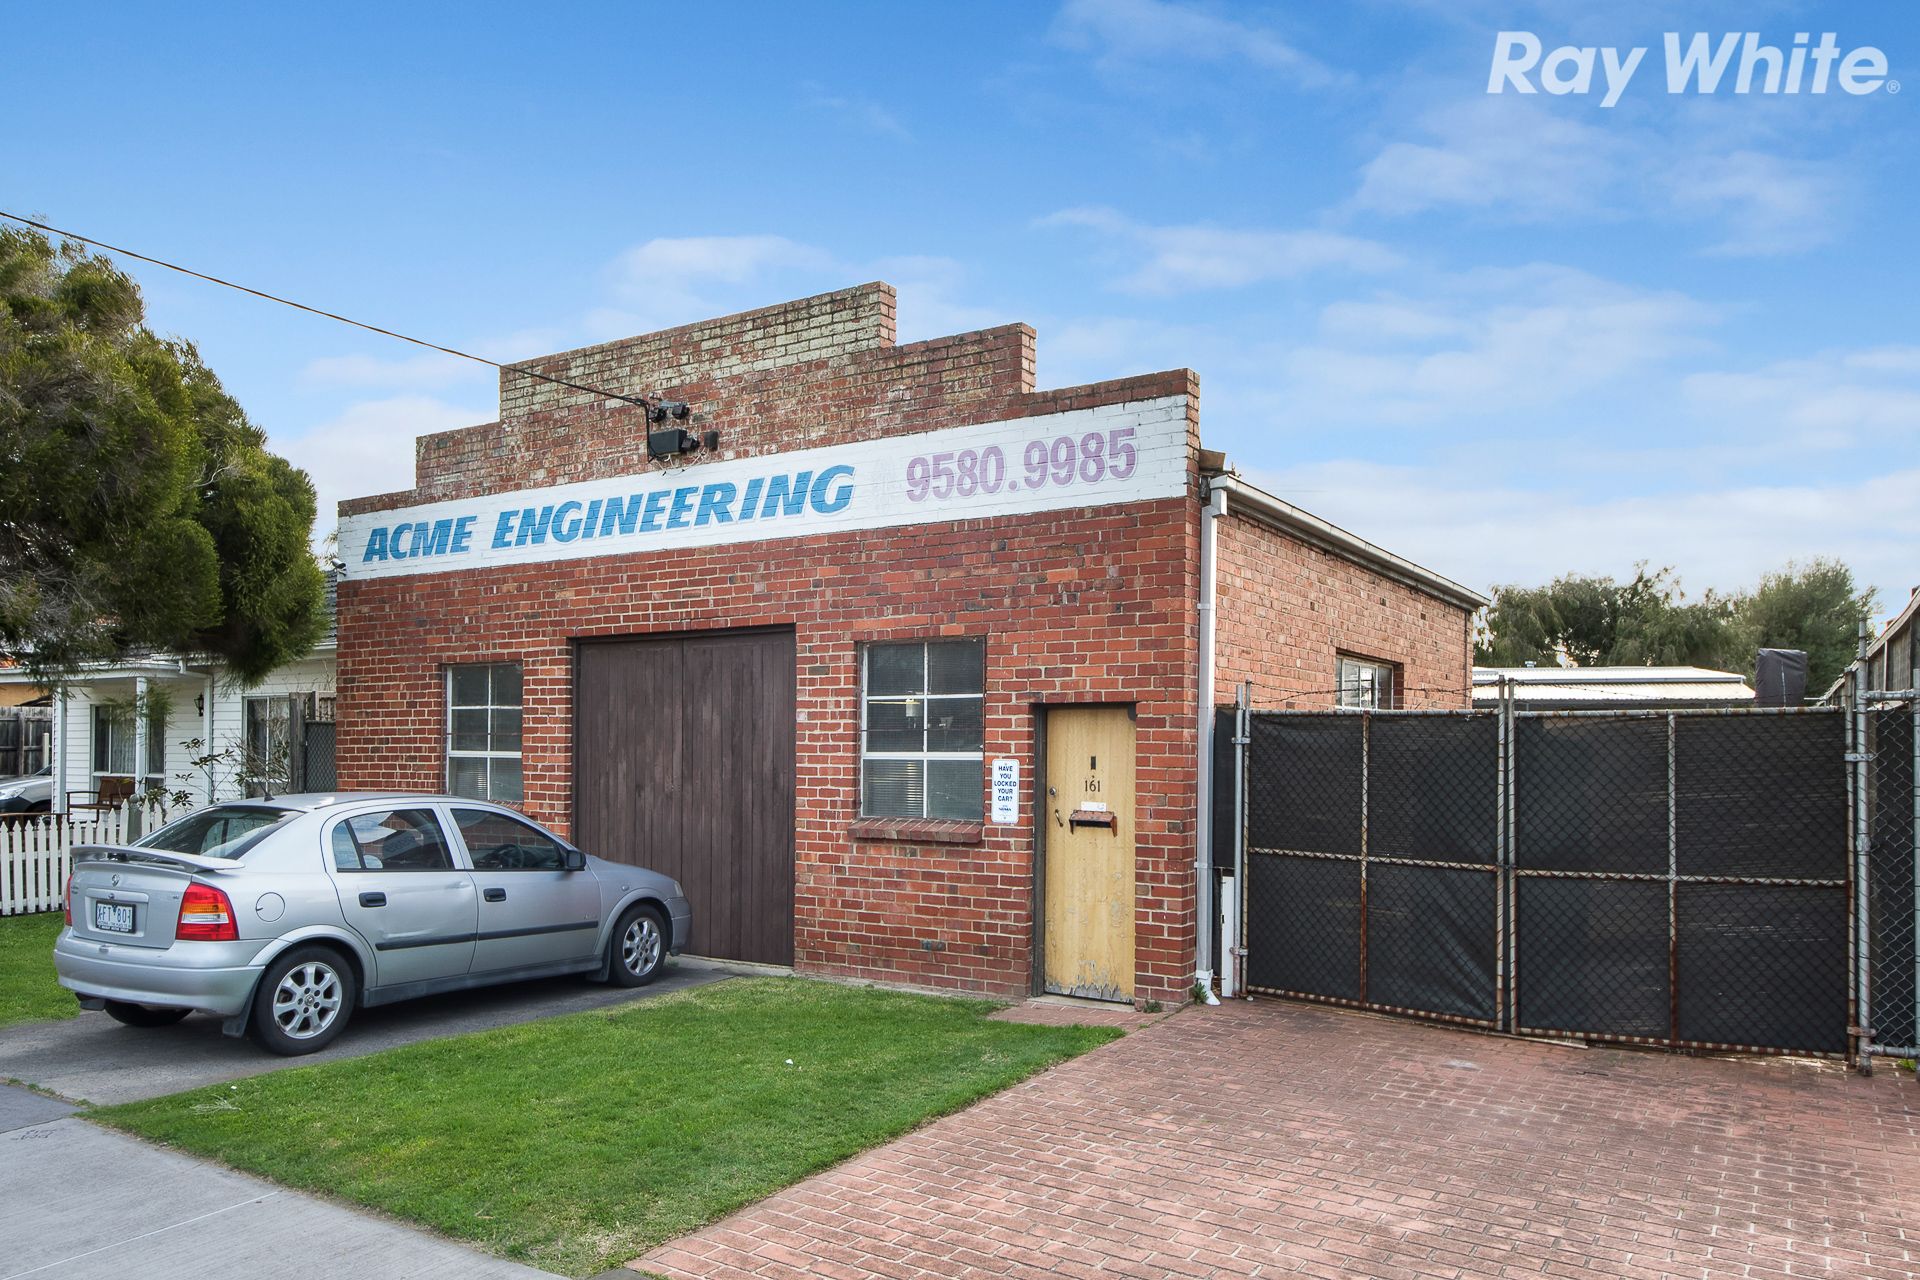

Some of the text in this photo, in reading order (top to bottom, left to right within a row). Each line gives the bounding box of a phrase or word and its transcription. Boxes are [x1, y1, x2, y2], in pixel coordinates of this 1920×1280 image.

[906, 427, 1137, 502] 9580.9985
[362, 464, 856, 563] ACME ENGINEERING
[1084, 779, 1101, 793] 161
